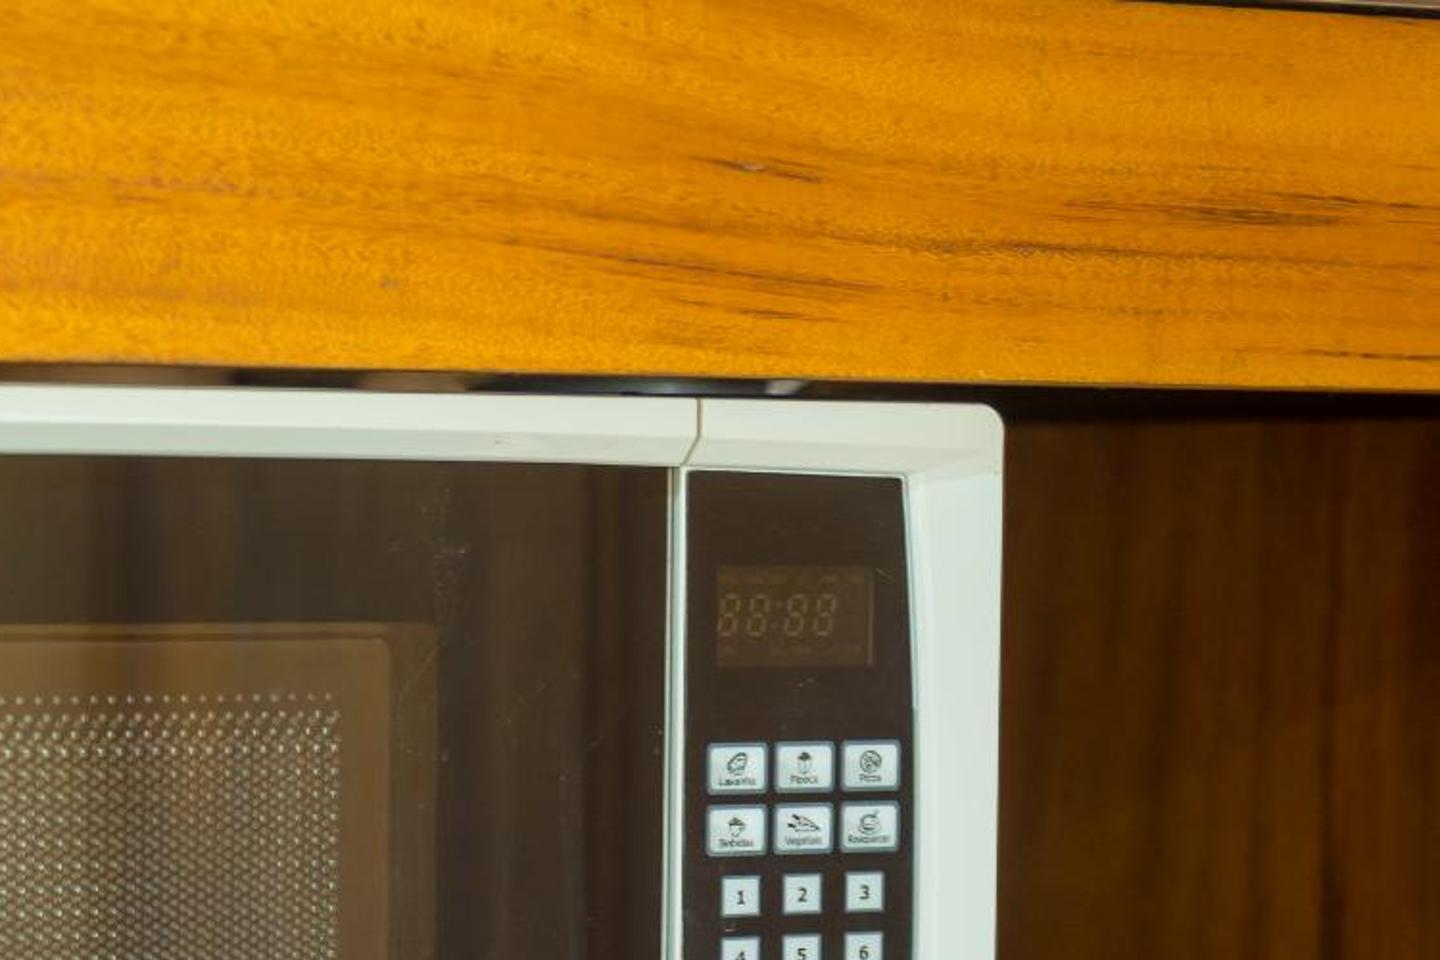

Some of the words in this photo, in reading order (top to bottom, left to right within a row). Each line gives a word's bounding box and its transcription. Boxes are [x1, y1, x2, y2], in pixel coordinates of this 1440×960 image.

[736, 890, 745, 905] 1
[797, 887, 808, 903] 2
[859, 884, 870, 900] 3
[858, 945, 869, 960] 6
